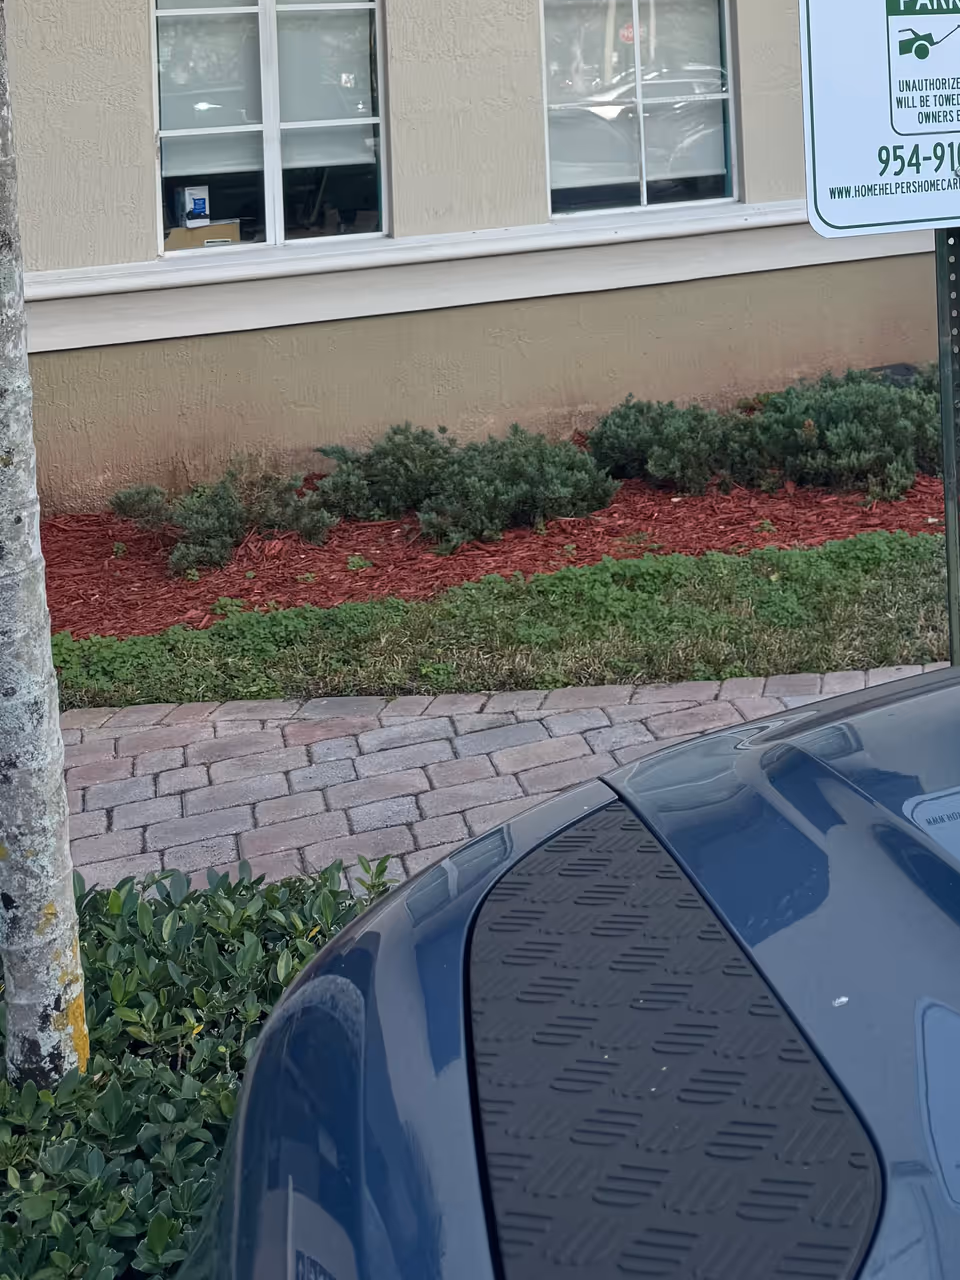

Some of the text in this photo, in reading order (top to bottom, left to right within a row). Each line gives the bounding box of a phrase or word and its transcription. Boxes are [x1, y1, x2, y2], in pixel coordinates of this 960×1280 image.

[896, 95, 918, 109] WILL
[919, 95, 931, 108] BE
[917, 110, 954, 124] OWNERS
